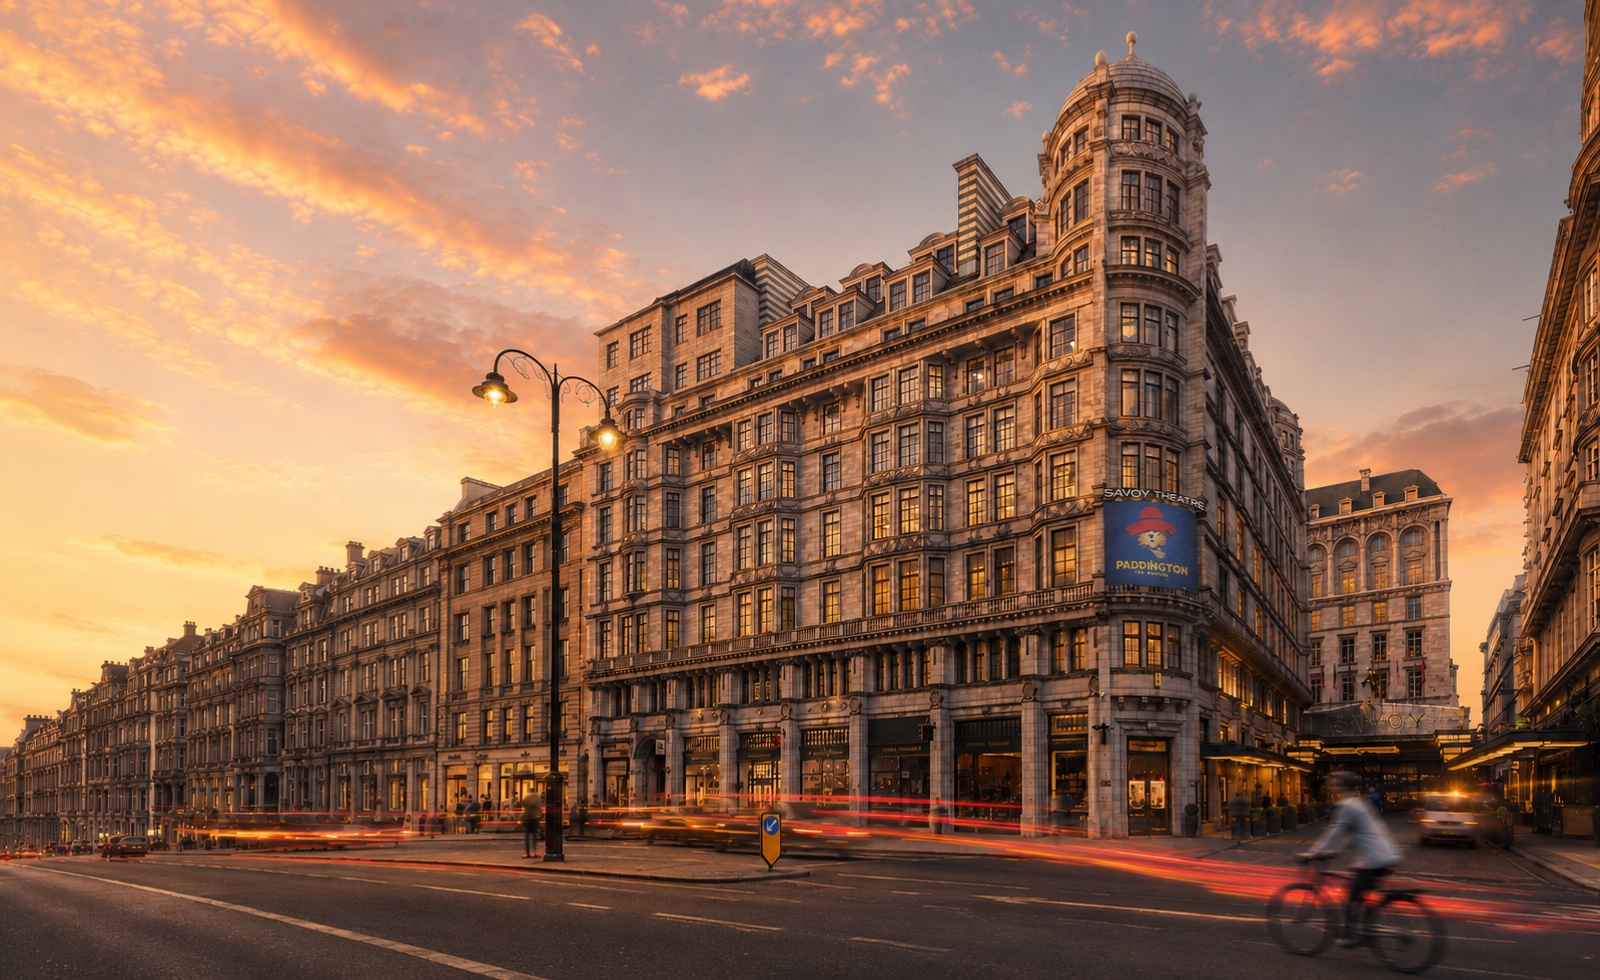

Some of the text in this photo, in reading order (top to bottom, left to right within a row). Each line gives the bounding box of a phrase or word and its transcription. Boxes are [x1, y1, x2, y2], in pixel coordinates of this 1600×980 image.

[1104, 488, 1204, 510] SAVOY THEATRE
[1116, 560, 1188, 576] PADDINGTON
